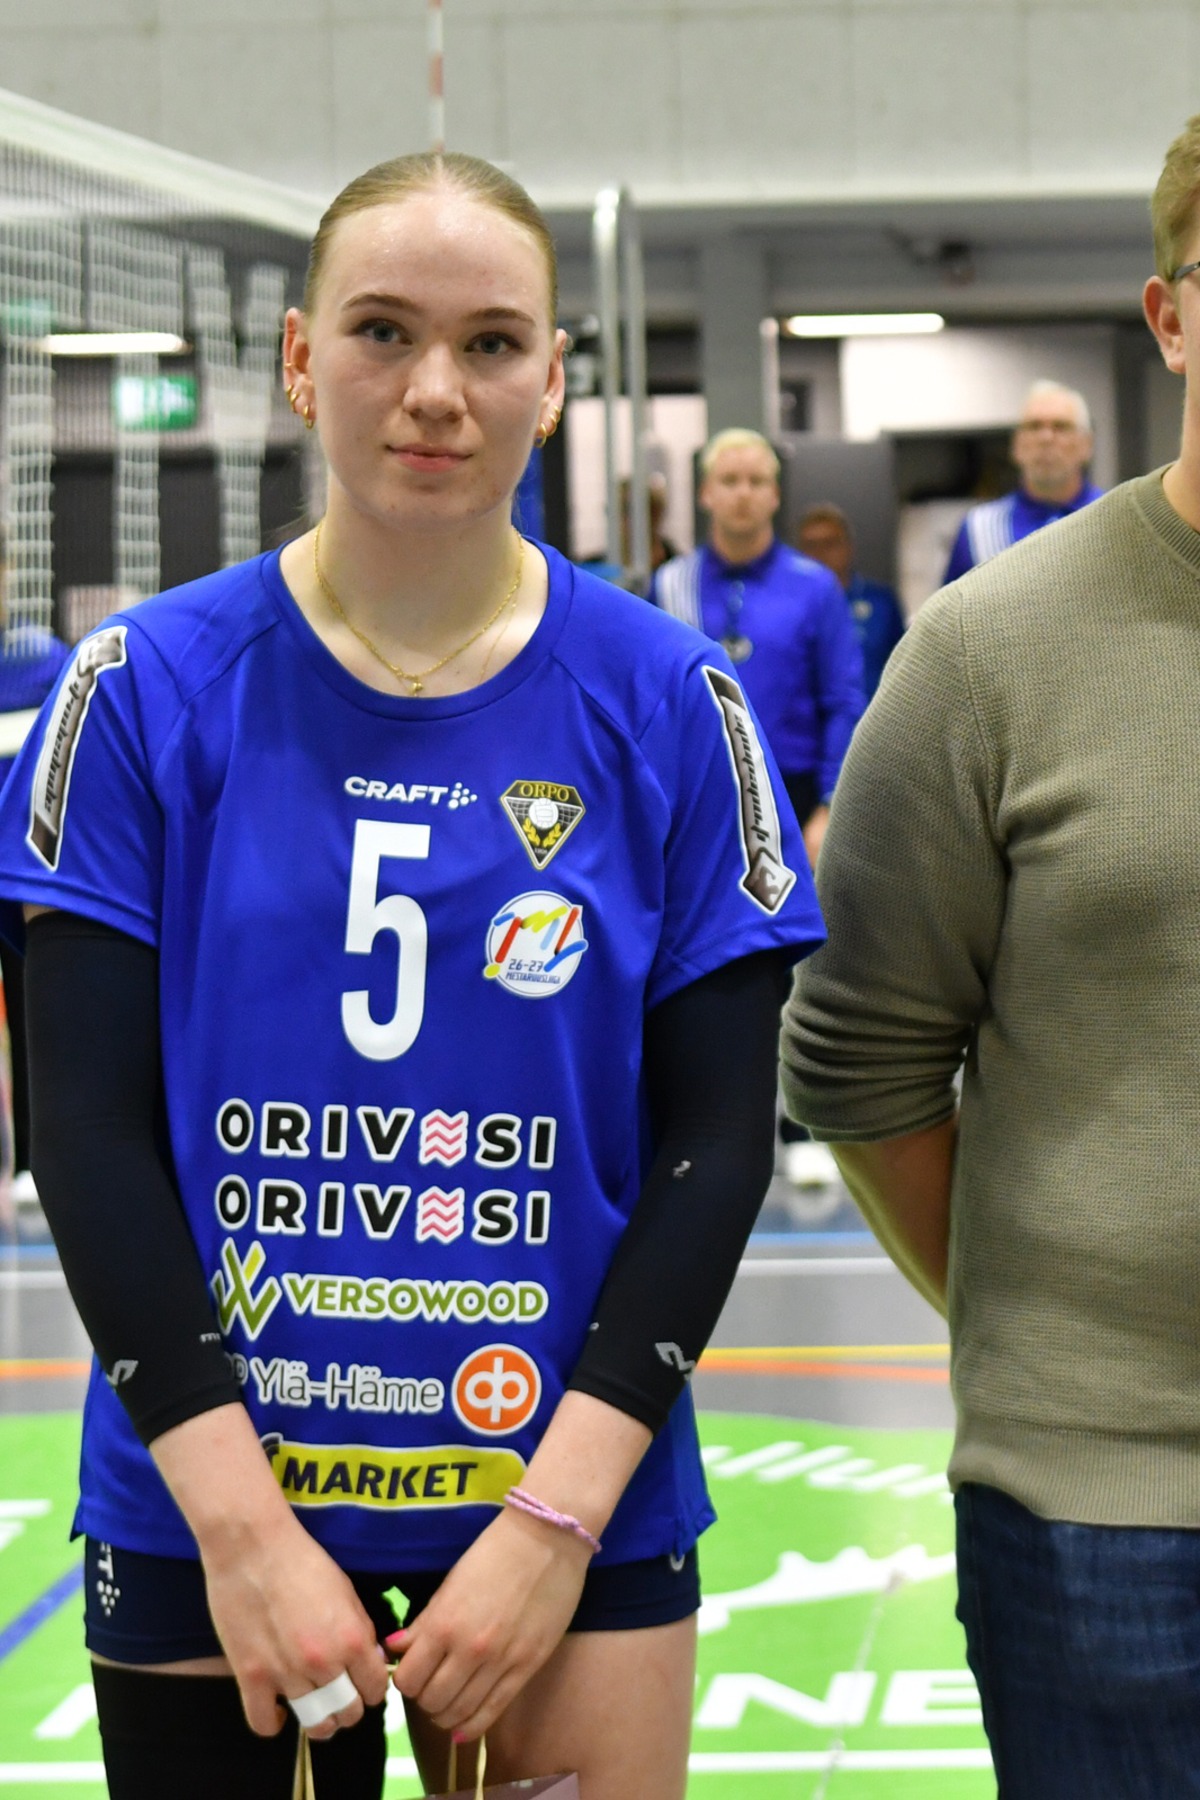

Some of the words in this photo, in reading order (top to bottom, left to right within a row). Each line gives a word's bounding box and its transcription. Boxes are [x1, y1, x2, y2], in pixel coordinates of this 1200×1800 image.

[344, 776, 449, 805] CRAFT
[519, 782, 570, 802] ORPO
[340, 818, 431, 1062] 5
[508, 958, 545, 973] 26-27
[284, 1275, 546, 1320] VERSOWOOD
[252, 1358, 443, 1412] Ylä-Häme
[280, 1456, 479, 1500] MARKET
